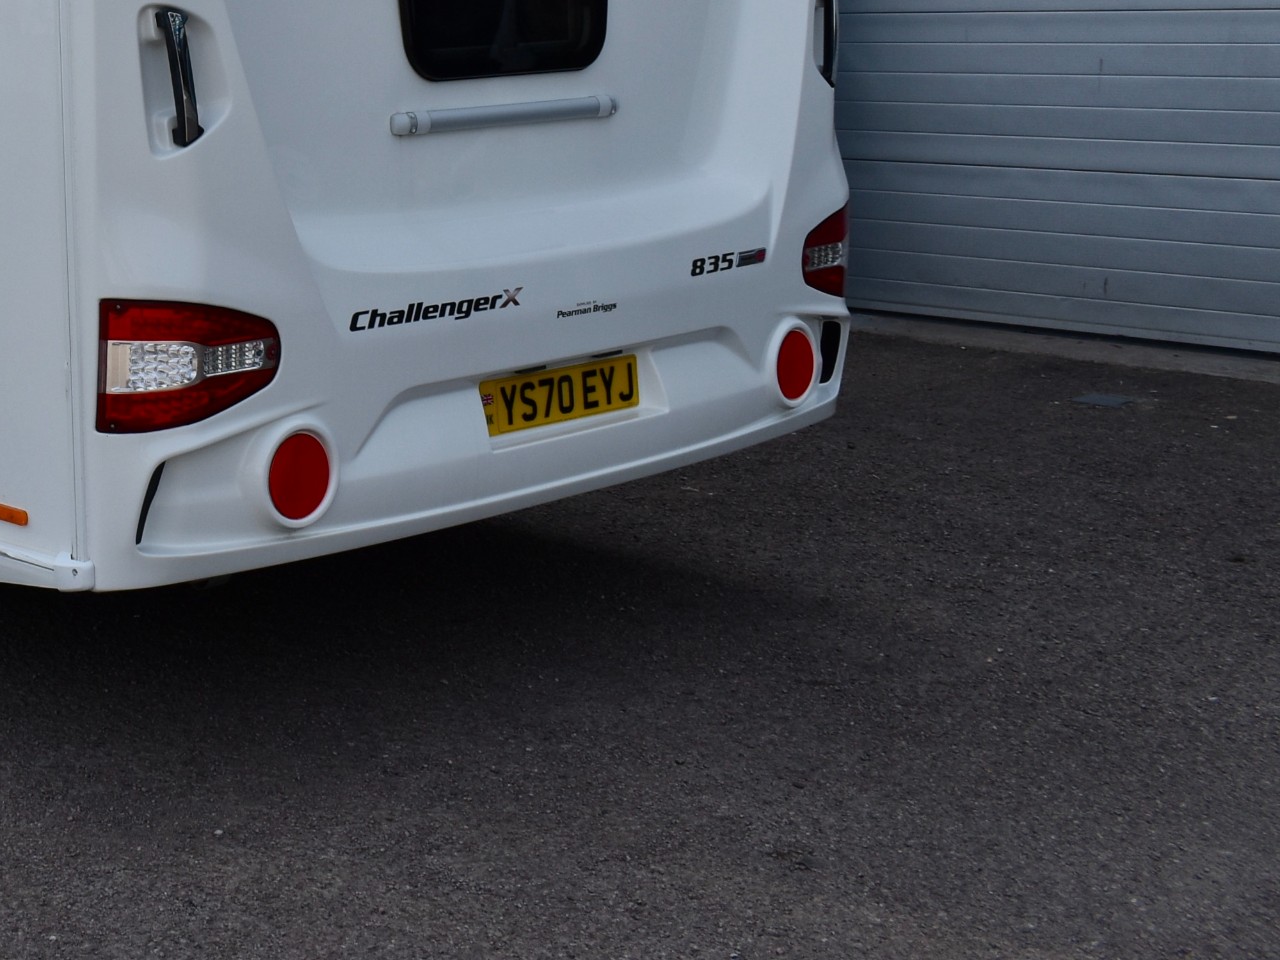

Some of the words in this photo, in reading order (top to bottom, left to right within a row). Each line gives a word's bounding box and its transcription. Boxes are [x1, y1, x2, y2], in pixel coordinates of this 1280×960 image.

[690, 251, 735, 277] 835
[556, 307, 592, 319] Pearman
[592, 302, 617, 313] Briggs
[500, 374, 575, 426] YS70
[581, 362, 634, 410] EYJ
